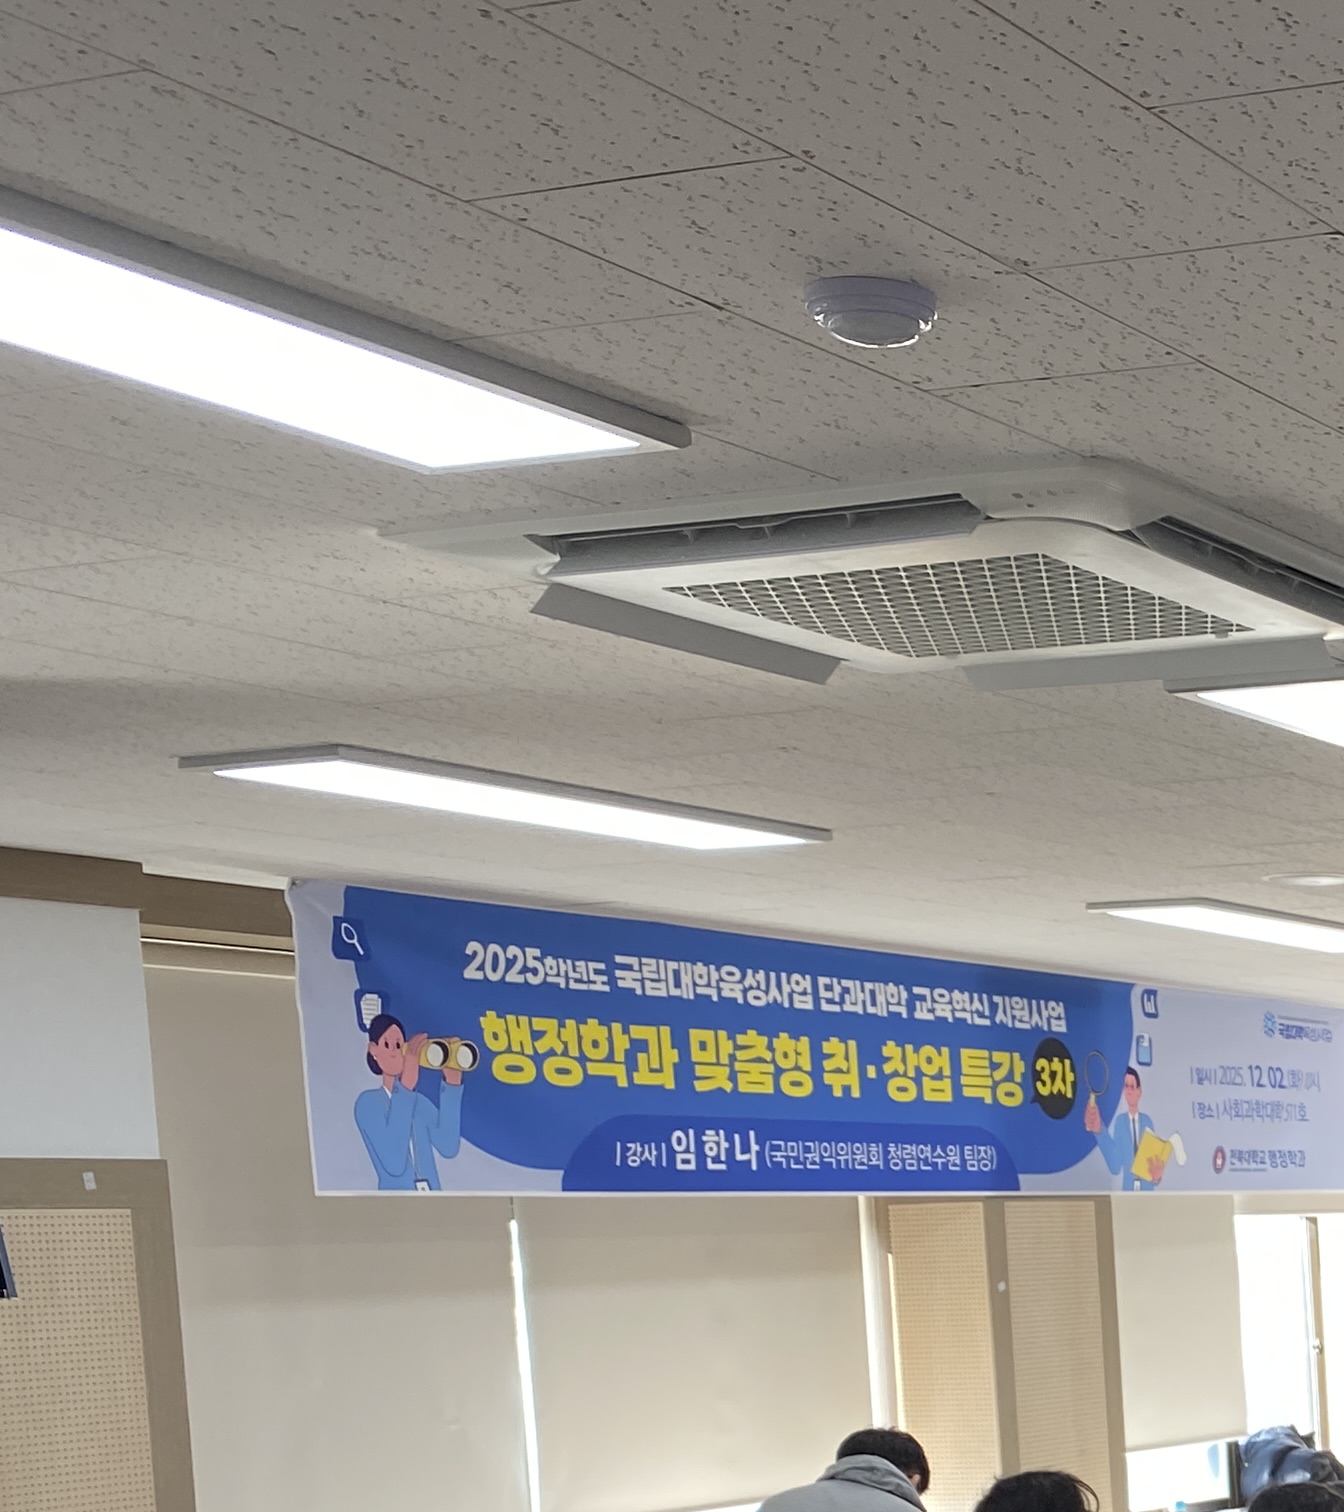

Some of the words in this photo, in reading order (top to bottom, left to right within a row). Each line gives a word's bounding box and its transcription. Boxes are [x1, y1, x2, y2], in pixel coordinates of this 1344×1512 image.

[463, 941, 610, 992] 2025학년도
[614, 954, 814, 1011] 국립대학육성사업
[817, 976, 908, 1019] 단과대학
[912, 985, 991, 1027] 교육혁신
[992, 994, 1068, 1033] 지원사업
[480, 1010, 680, 1090] 행정학과
[688, 1028, 814, 1098] 맞춤형
[960, 1047, 1026, 1107] 특강
[1035, 1057, 1075, 1099] 3차
[625, 1143, 658, 1167] 강사
[887, 1142, 961, 1172] 청렴연수원
[964, 1145, 997, 1172] 팀장)
[1268, 1150, 1306, 1169] 행정학과
